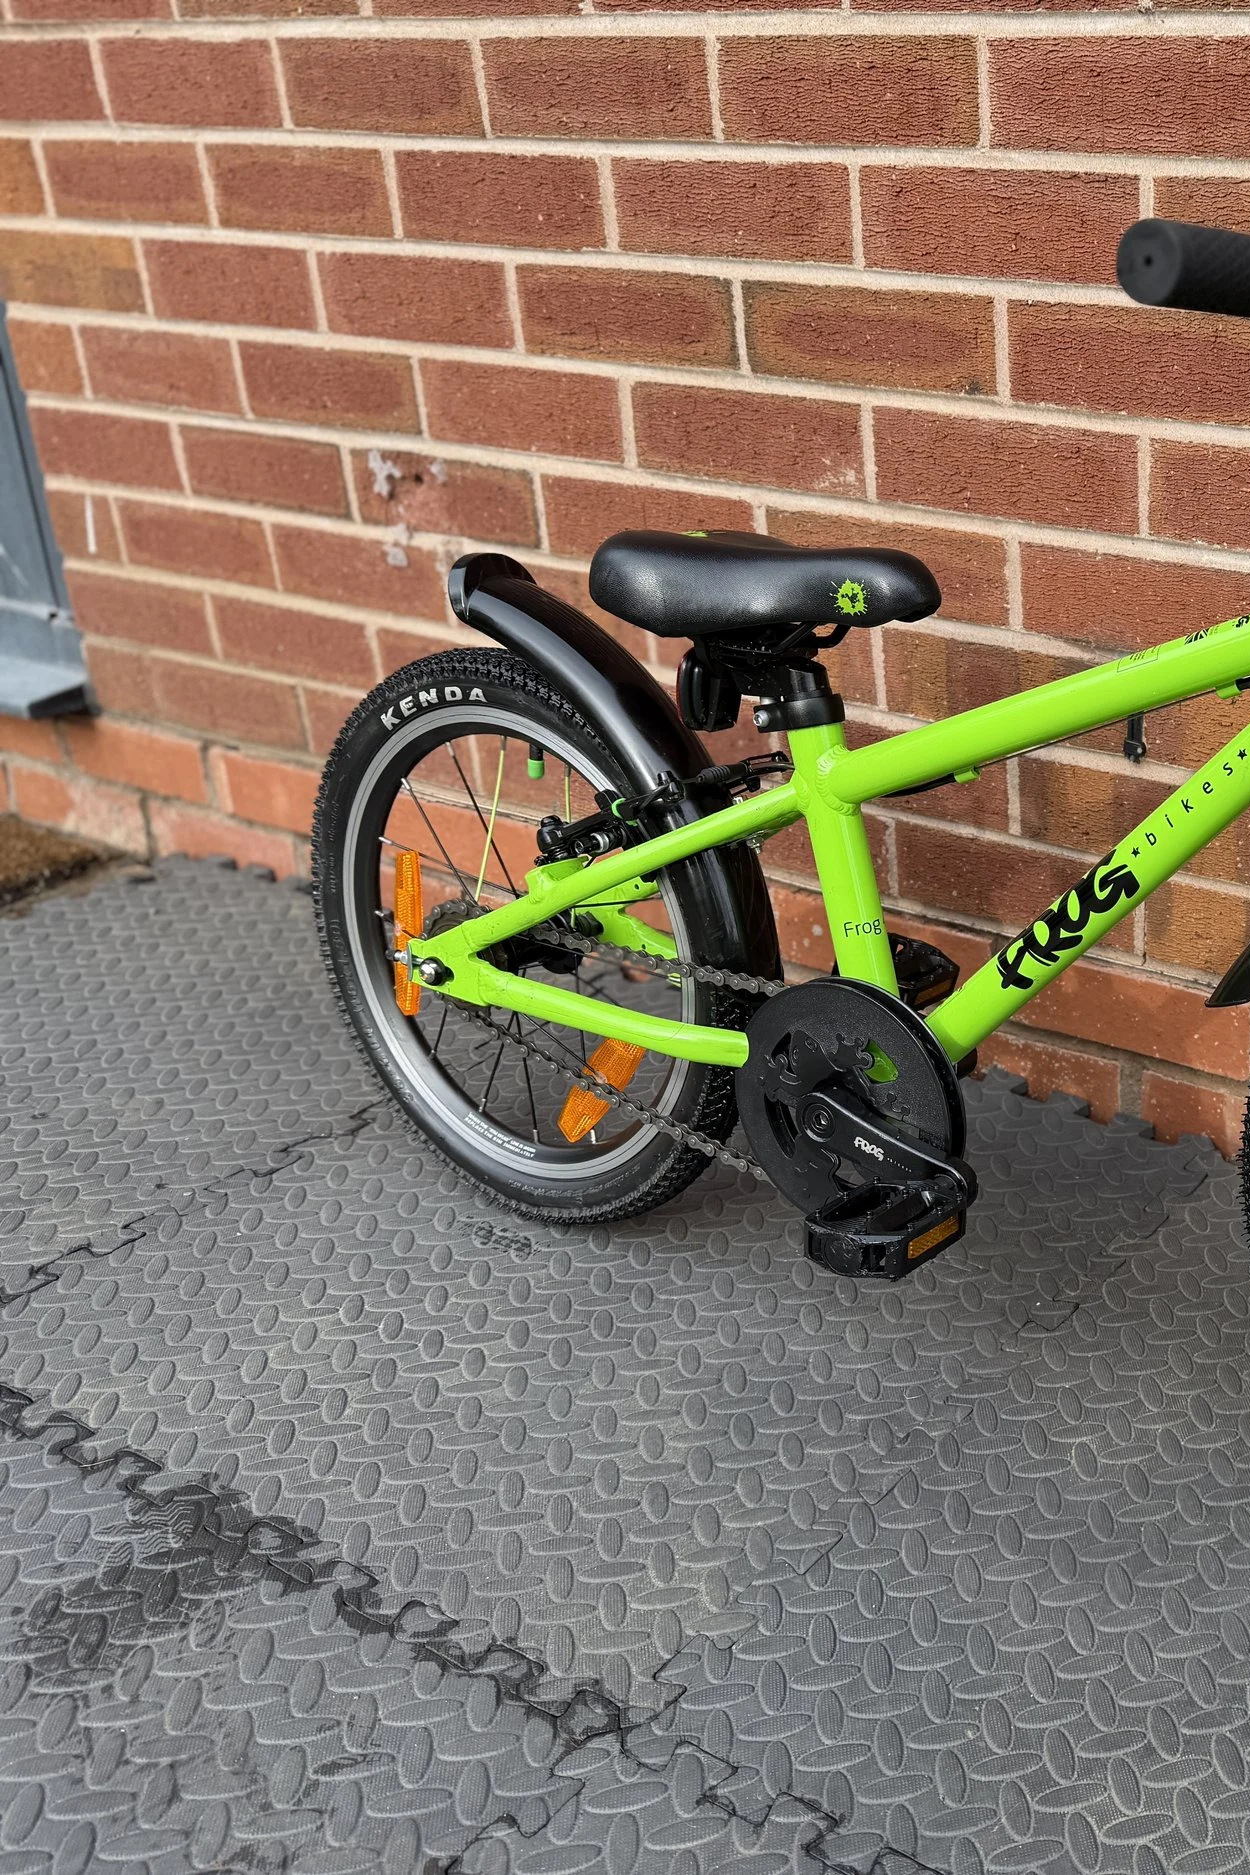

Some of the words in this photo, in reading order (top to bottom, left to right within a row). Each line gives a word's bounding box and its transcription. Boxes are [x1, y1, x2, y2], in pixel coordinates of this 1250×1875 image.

[380, 686, 488, 731] KENDA
[996, 848, 1141, 990] FROG
[1145, 762, 1234, 846] bikes
[843, 918, 882, 938] Frog
[853, 1136, 885, 1161] FROG
